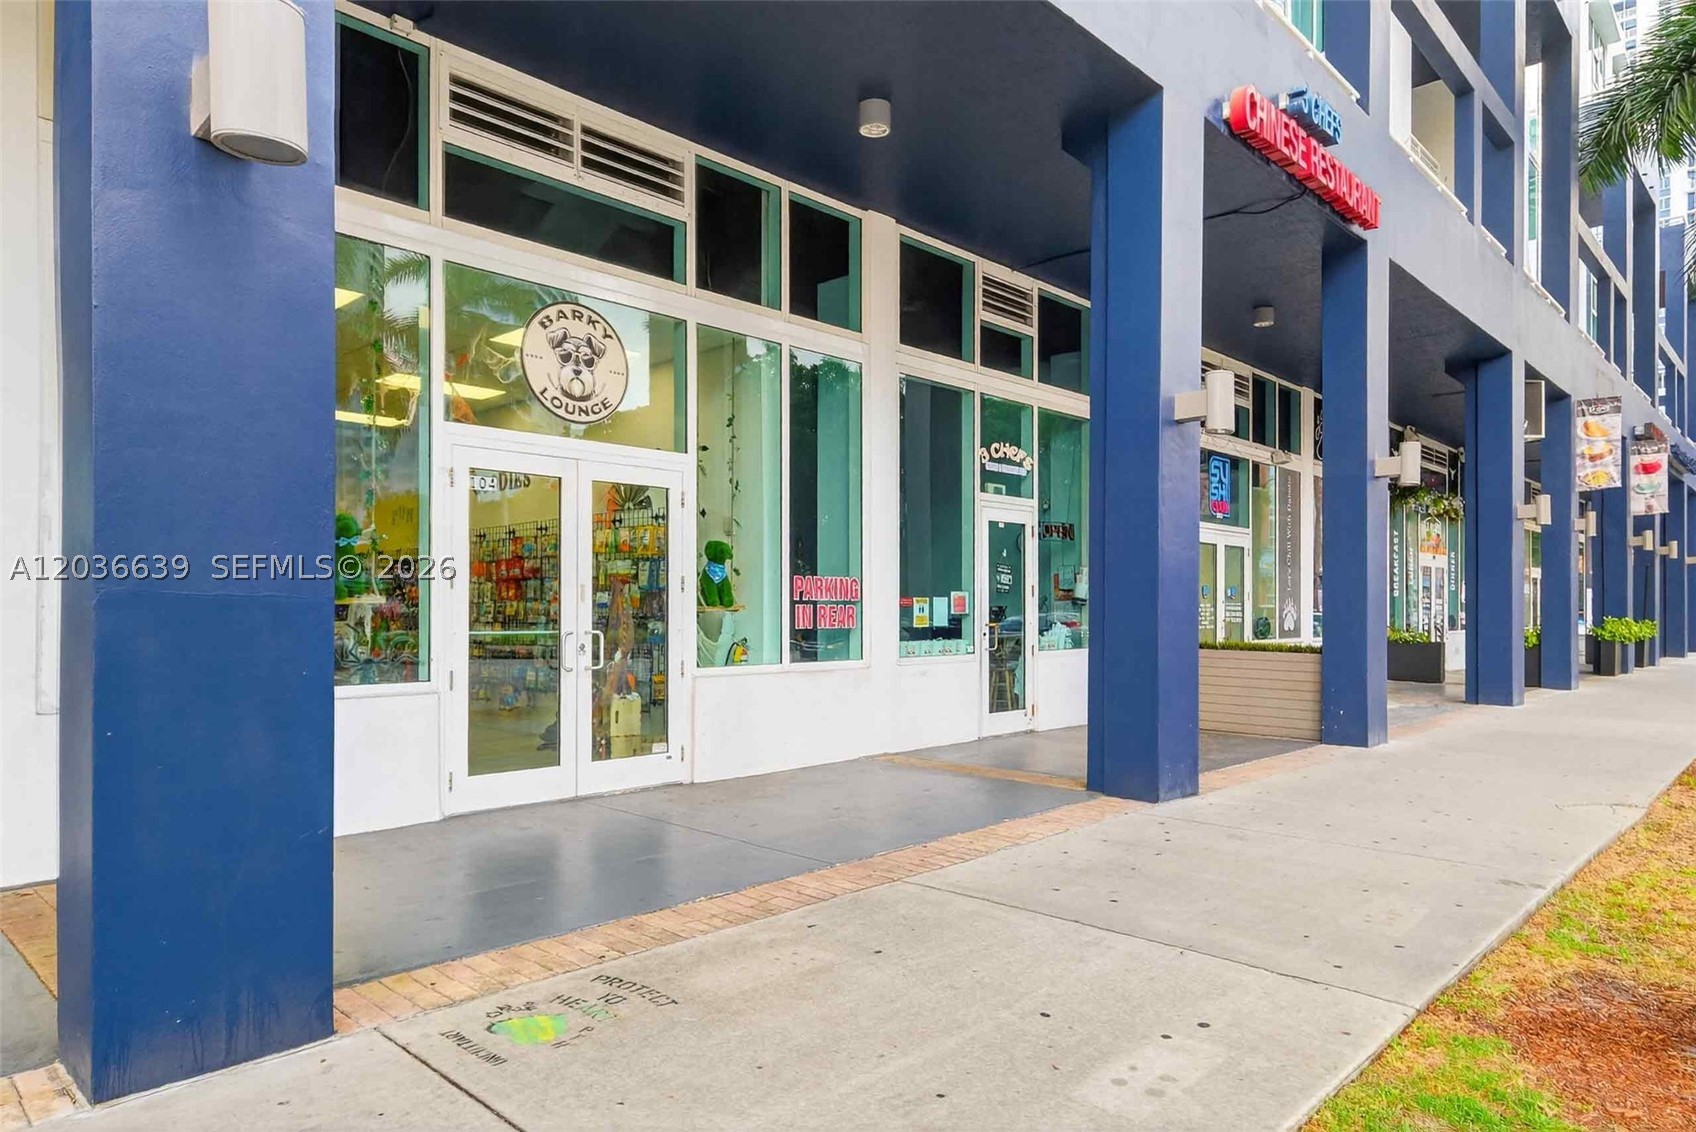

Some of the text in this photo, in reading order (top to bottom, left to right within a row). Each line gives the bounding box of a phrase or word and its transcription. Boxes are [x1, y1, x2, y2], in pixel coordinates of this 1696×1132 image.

[1311, 97, 1342, 146] CHEFS
[1236, 84, 1382, 230] CHINESE RESTAURANT
[537, 308, 615, 341] BARKY
[539, 387, 614, 417] LOUNGE
[794, 575, 860, 601] PARKING
[795, 604, 856, 629] IN REAR
[591, 974, 678, 1007] PROTECT
[597, 992, 627, 1006] YO
